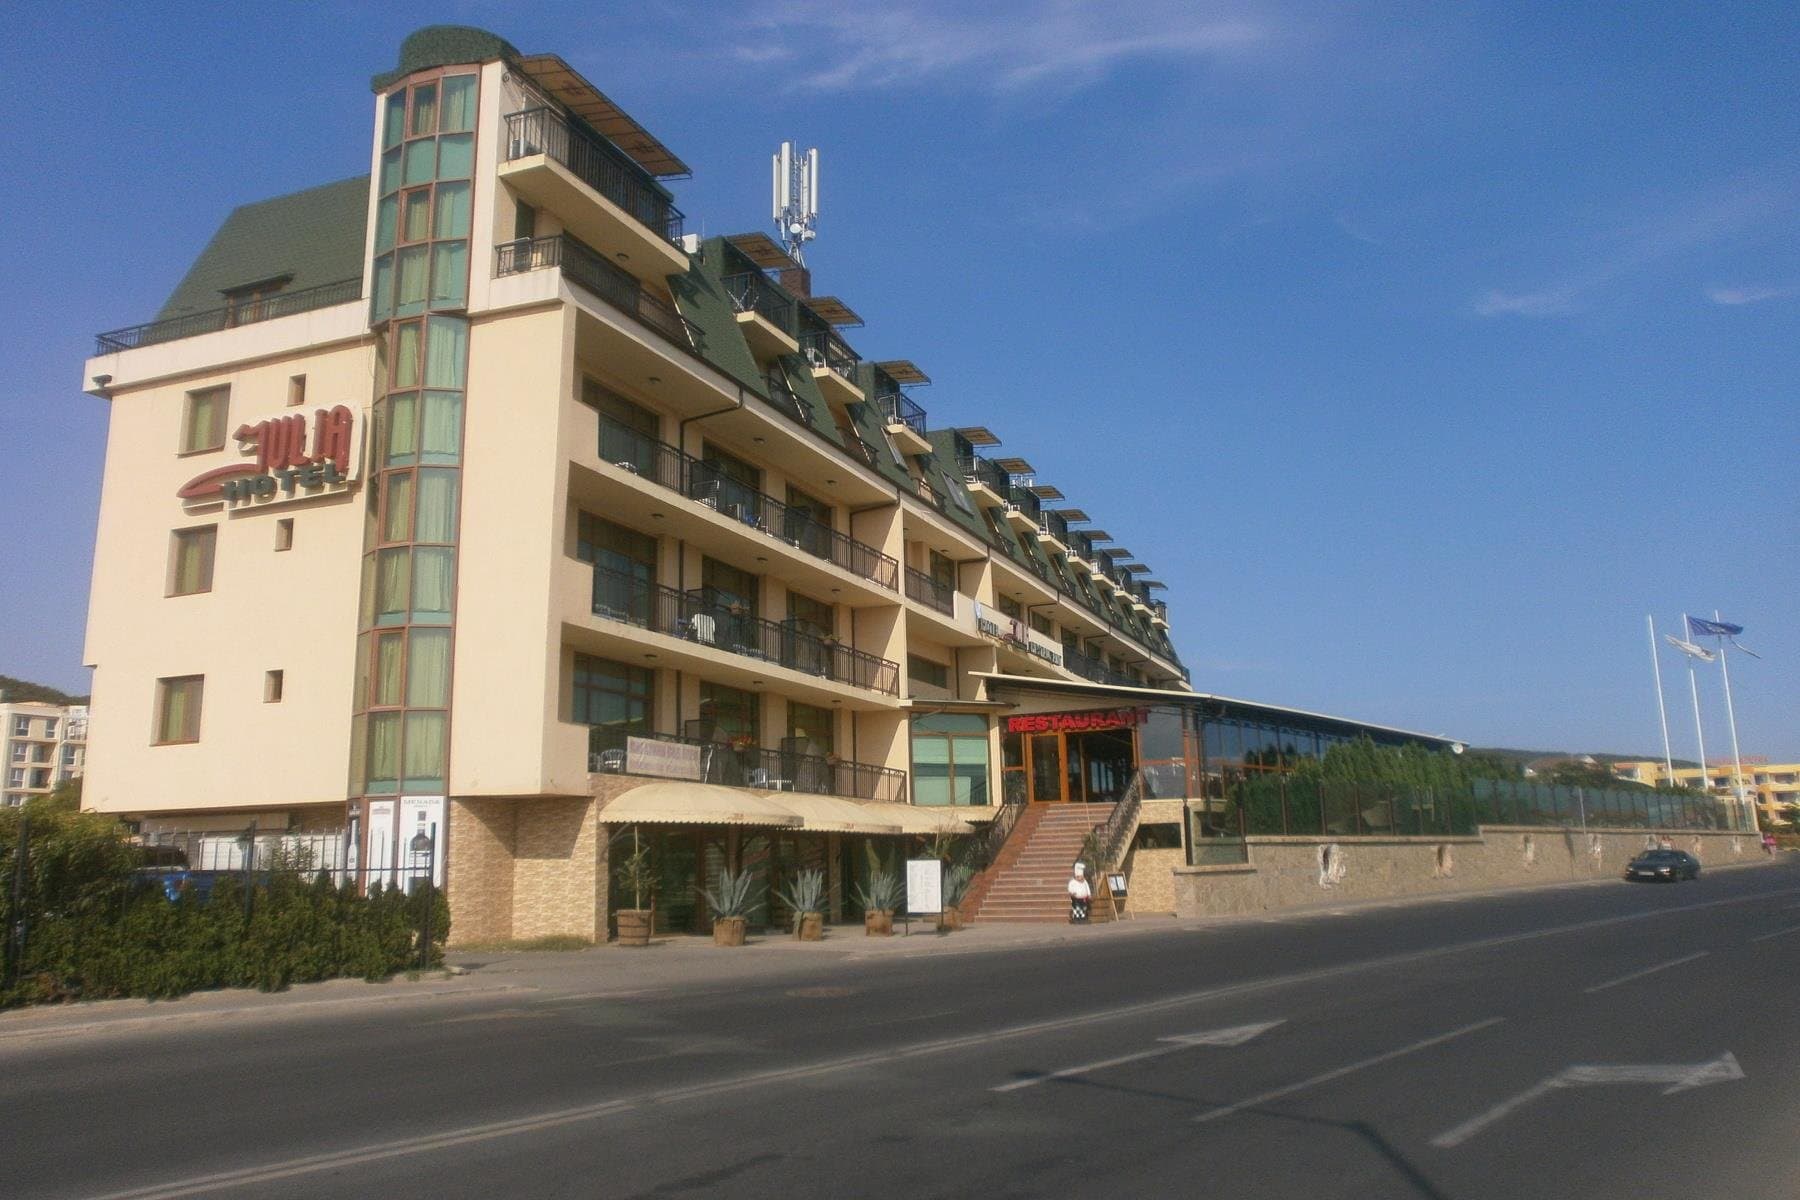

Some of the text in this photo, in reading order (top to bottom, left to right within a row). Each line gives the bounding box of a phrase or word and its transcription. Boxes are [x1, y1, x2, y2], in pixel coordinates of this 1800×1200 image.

[232, 405, 352, 472] JULIA
[223, 463, 347, 501] HOTEL
[1008, 708, 1149, 732] RESTAURANT
